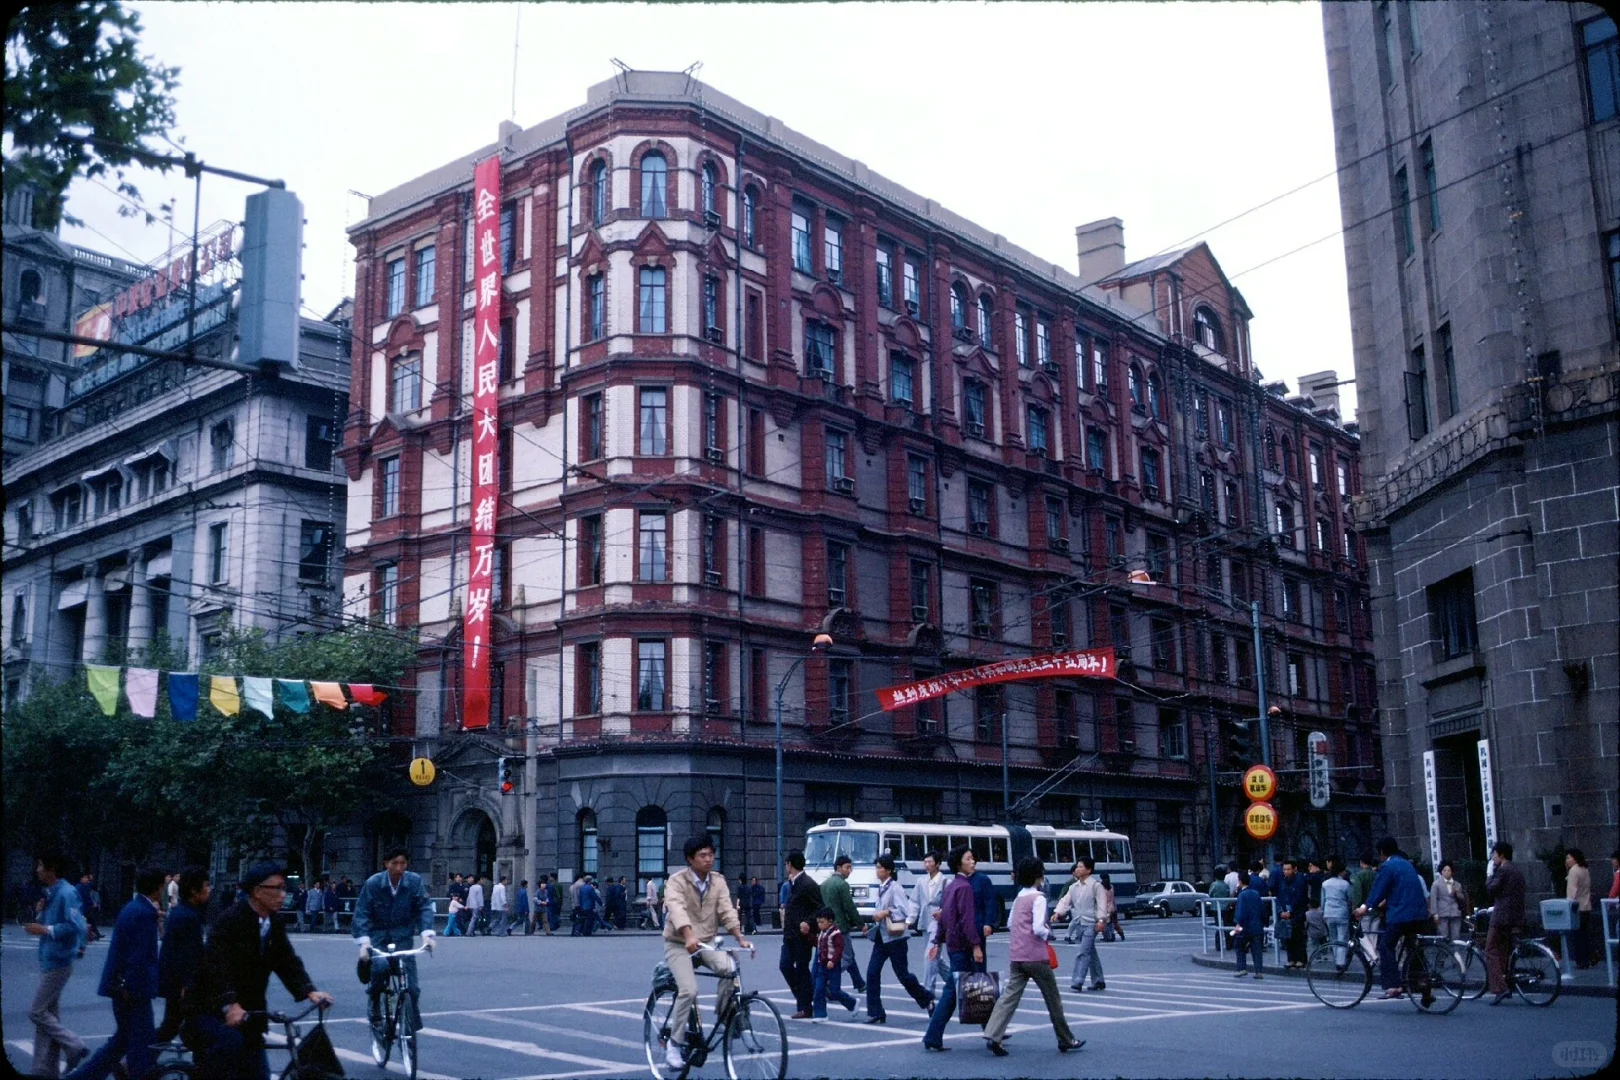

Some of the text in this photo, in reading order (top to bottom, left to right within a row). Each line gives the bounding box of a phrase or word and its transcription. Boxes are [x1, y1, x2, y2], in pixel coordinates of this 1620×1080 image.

[468, 188, 498, 669] 全世界人民大团结万岁！
